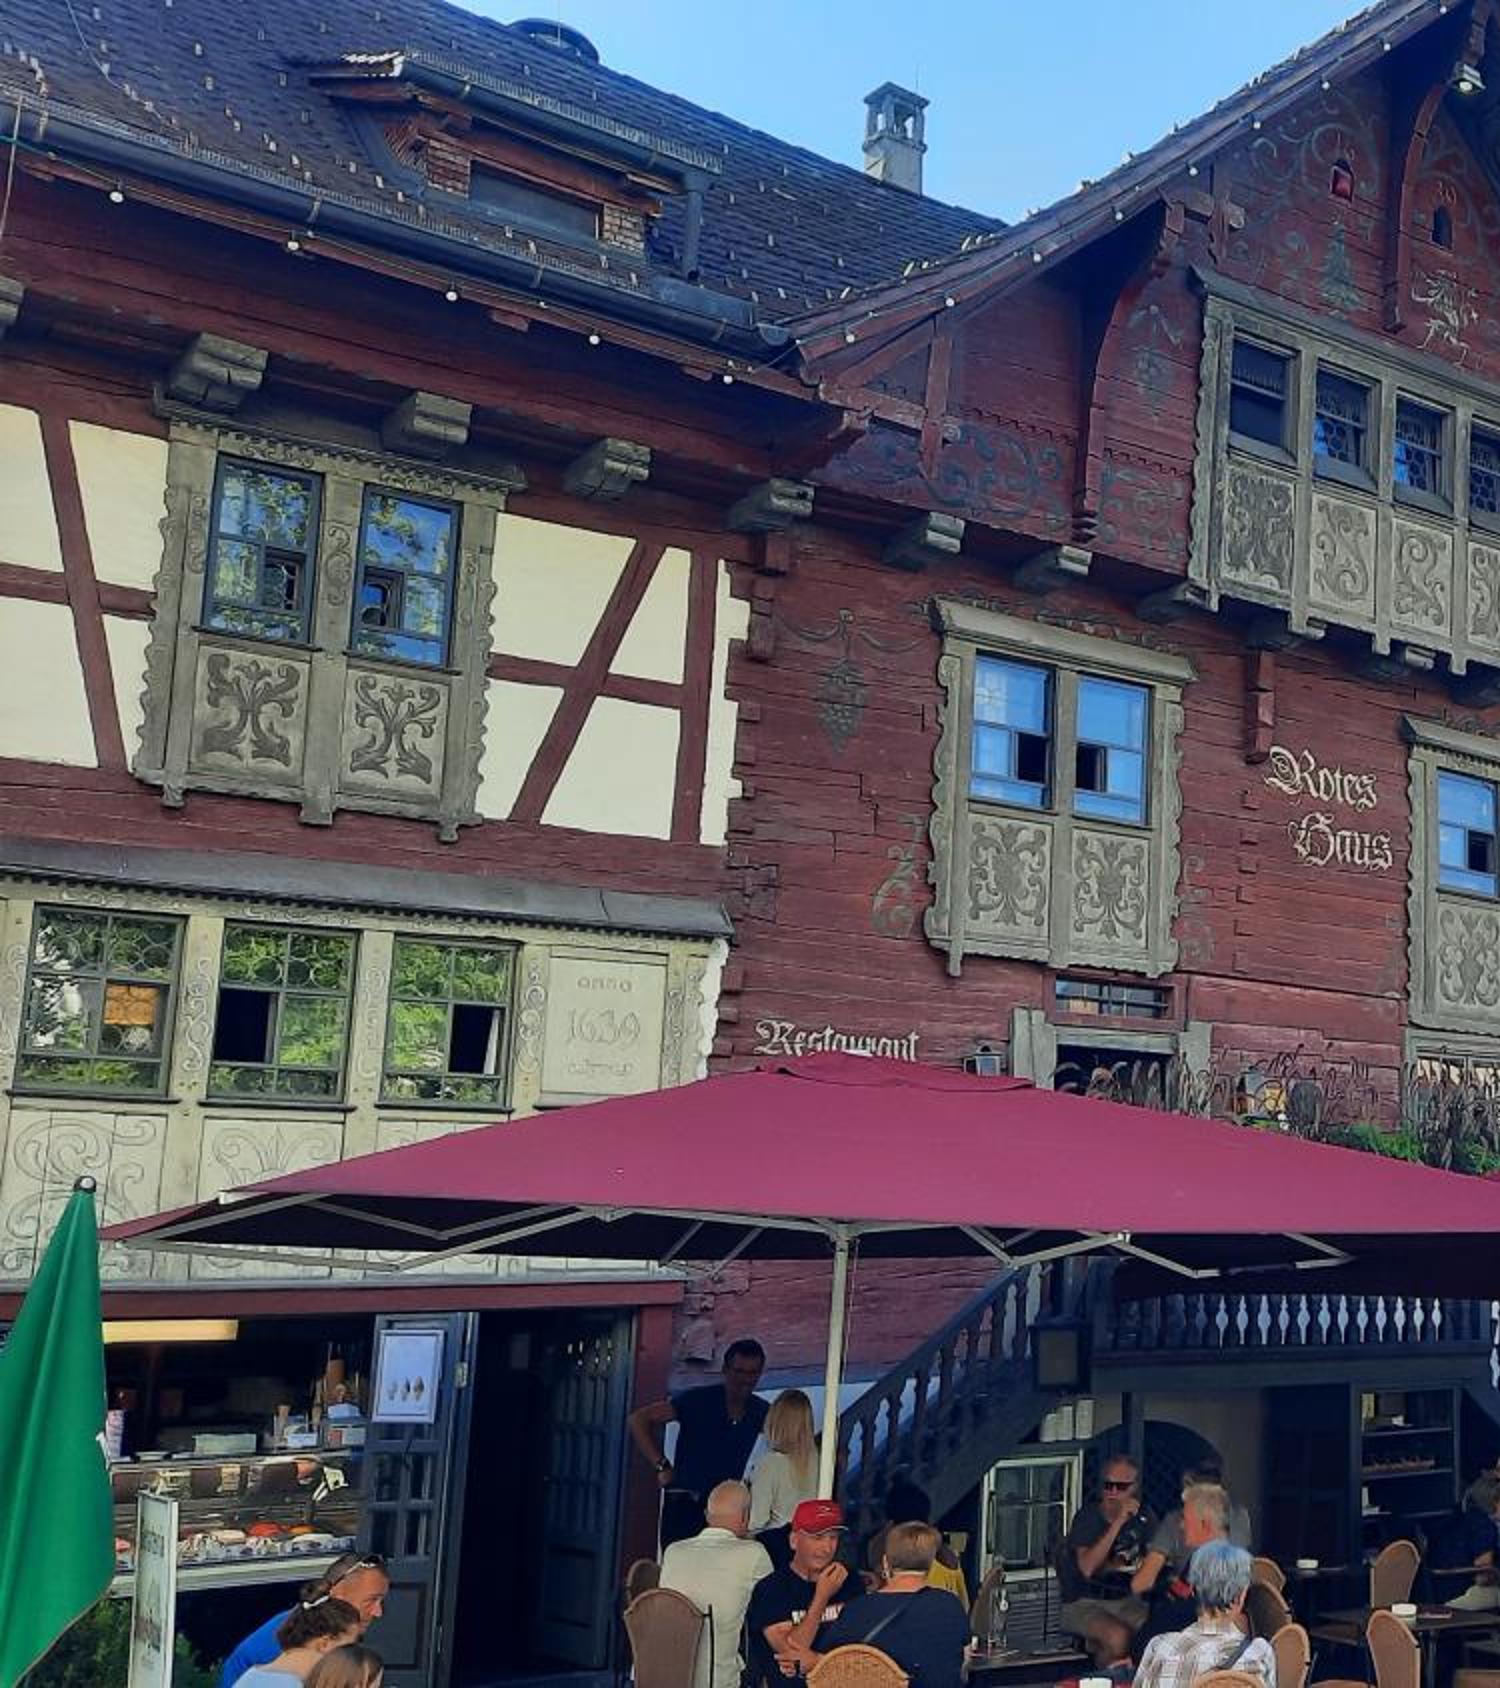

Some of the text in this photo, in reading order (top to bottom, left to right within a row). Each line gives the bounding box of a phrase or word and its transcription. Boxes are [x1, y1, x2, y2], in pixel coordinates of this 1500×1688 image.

[1263, 746, 1377, 812] Rotes
[1287, 812, 1393, 871] Haus
[753, 1018, 920, 1063] Restaurant
